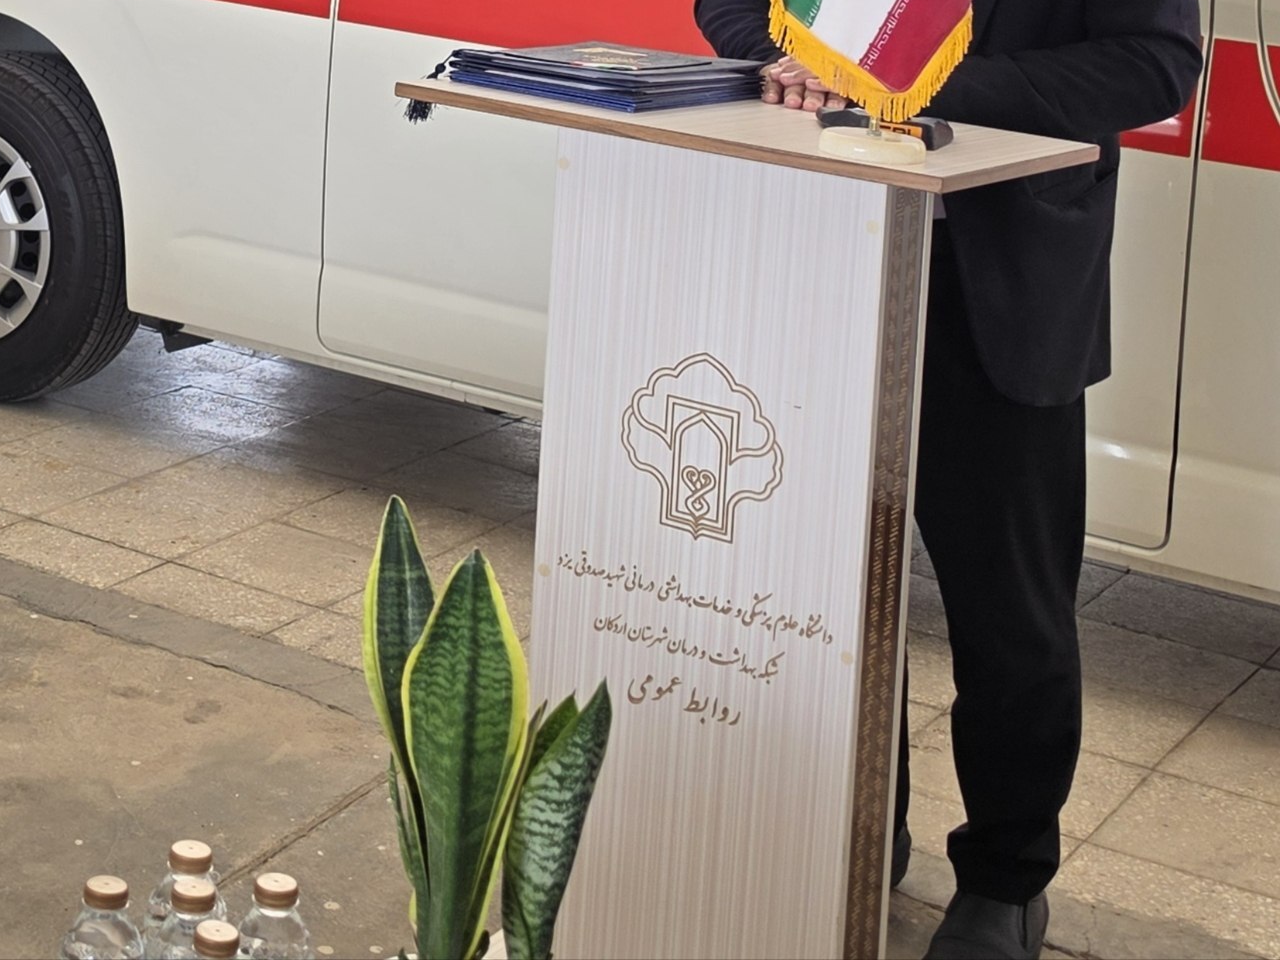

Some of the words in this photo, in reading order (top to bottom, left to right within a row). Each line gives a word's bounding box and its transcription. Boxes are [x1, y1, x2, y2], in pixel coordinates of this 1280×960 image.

[557, 553, 573, 570] یزد
[574, 550, 606, 577] صدوقی
[603, 564, 626, 588] شهید
[624, 565, 655, 592] درمانی
[657, 574, 693, 608] بهداشتی
[692, 596, 733, 615] خدمات
[735, 607, 742, 618] و
[741, 592, 773, 630] پزشکی
[593, 614, 627, 635] اردکان
[627, 625, 668, 648] شهرستان
[773, 614, 799, 642] علوم
[799, 613, 833, 645] دانشگاه
[666, 639, 698, 657] درمان
[699, 650, 706, 660] و
[708, 647, 757, 679] بهداشت
[758, 651, 785, 685] شبکه
[627, 674, 682, 705] عمومی
[683, 687, 741, 726] روابط
